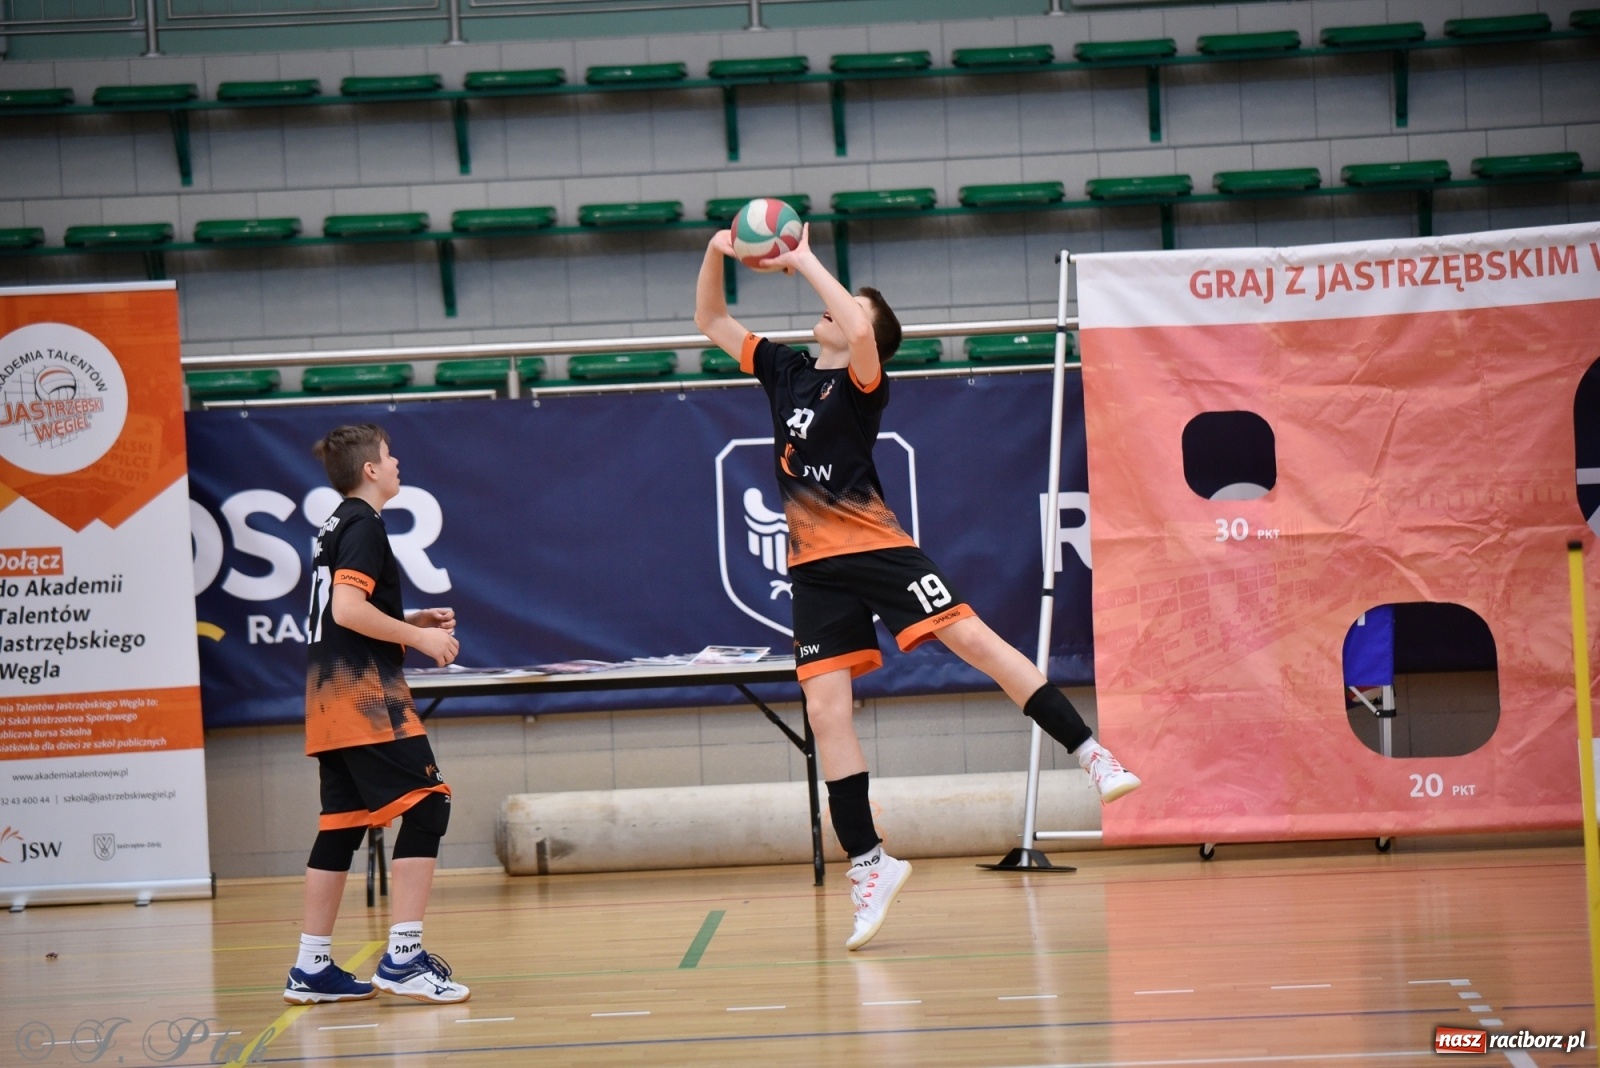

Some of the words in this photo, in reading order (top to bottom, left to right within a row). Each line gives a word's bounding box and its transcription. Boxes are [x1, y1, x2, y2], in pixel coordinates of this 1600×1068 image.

[1189, 267, 1275, 304] GRAJ
[1284, 265, 1306, 295] Z
[1315, 245, 1579, 302] JASTRZĘBSKIM
[0, 350, 43, 392] ADEMIA
[32, 417, 91, 443] WĘGIEL
[1215, 517, 1249, 542] 30
[1257, 529, 1281, 540] PKT
[25, 574, 123, 597] Akademii
[906, 573, 952, 615] 19
[800, 644, 820, 658] JSW
[0, 660, 61, 684] Węgla
[15, 702, 55, 712] Talentów
[56, 699, 118, 712] Jastrzębskiego
[119, 698, 146, 709] Węgla
[146, 698, 159, 707] to:
[8, 715, 30, 725] Szkół
[32, 714, 85, 724] Mistrzostwa
[85, 713, 138, 724] Sportowego
[34, 729, 58, 738] Bursa
[59, 727, 93, 737] Szkolna
[41, 741, 55, 750] dla
[56, 739, 82, 750] dzieci
[93, 738, 116, 748] szkół
[117, 736, 167, 750] publicznych
[12, 768, 129, 782] www.akademiatalentowjw.pl
[1409, 773, 1444, 798] 20
[1452, 785, 1476, 796] PKT
[11, 797, 21, 805] 43
[22, 796, 38, 805] 400
[40, 796, 51, 804] 44
[20, 841, 63, 864] JSW
